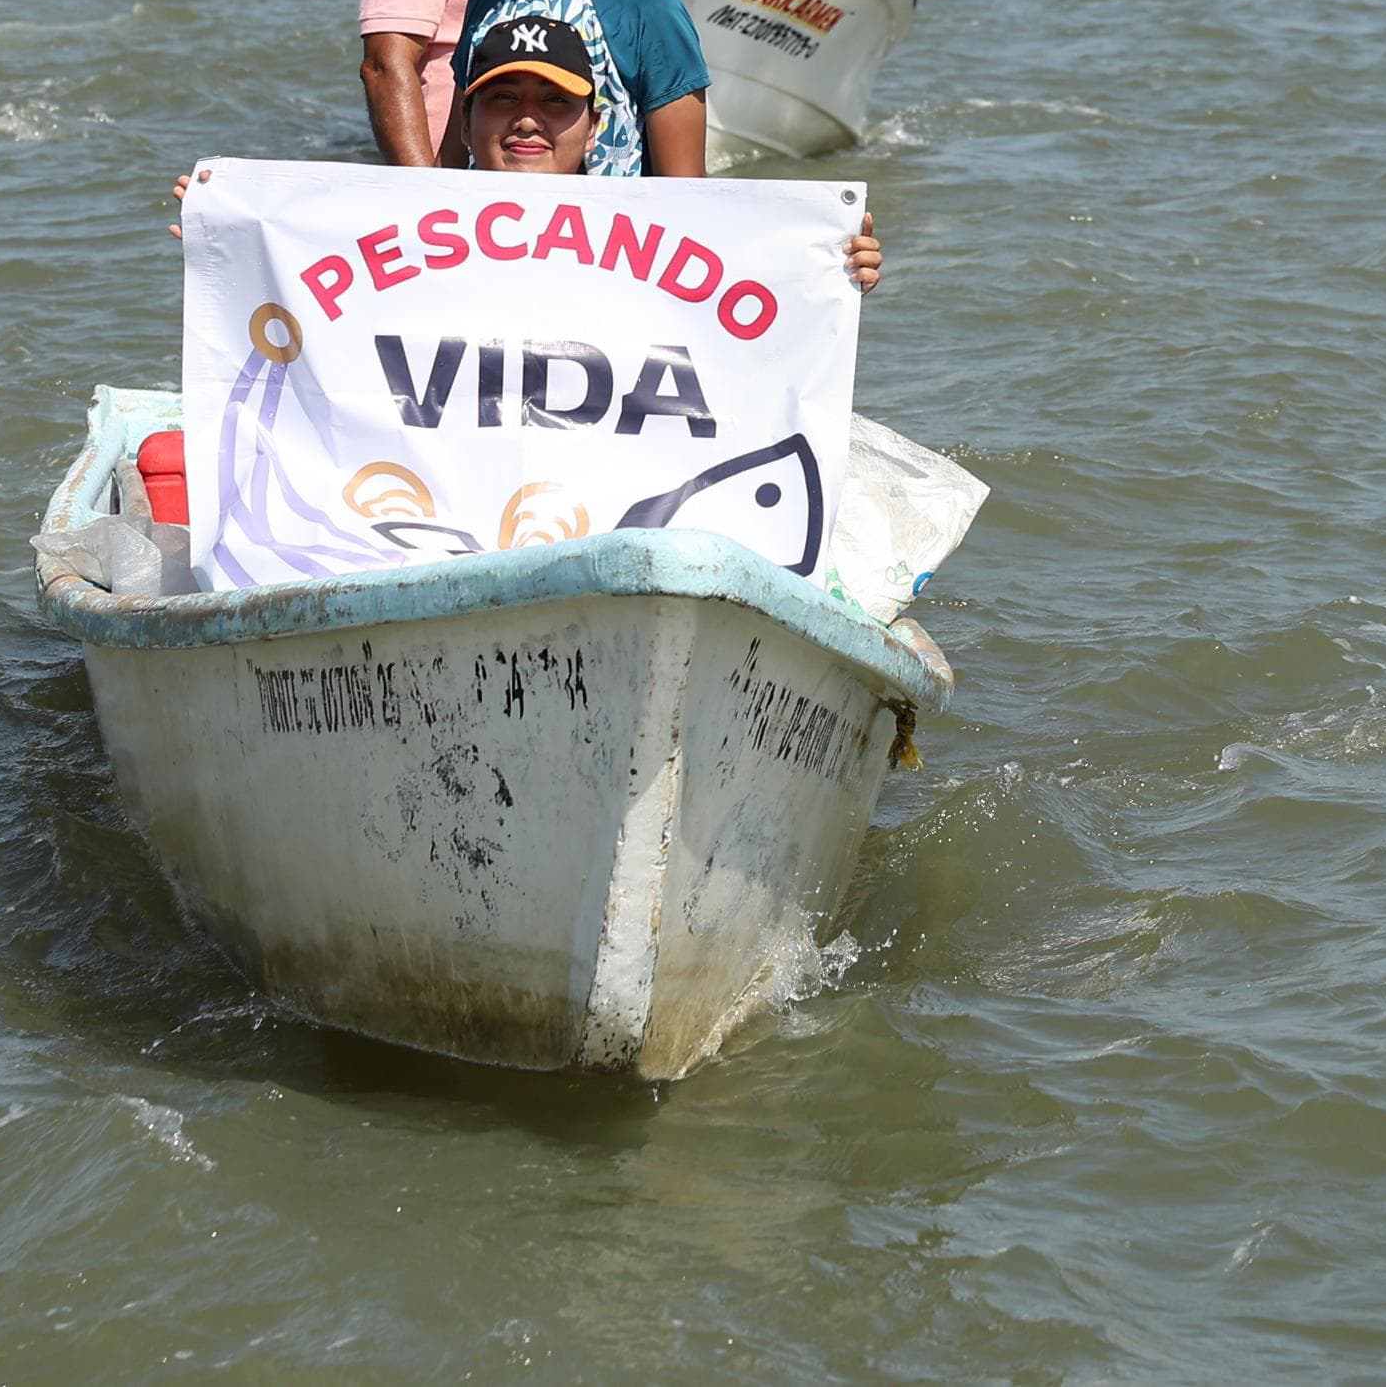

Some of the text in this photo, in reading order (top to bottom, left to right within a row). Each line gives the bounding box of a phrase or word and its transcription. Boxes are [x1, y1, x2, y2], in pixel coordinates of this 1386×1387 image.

[510, 23, 549, 53] NY
[300, 201, 779, 342] PESCANDO
[374, 334, 718, 439] VIDA
